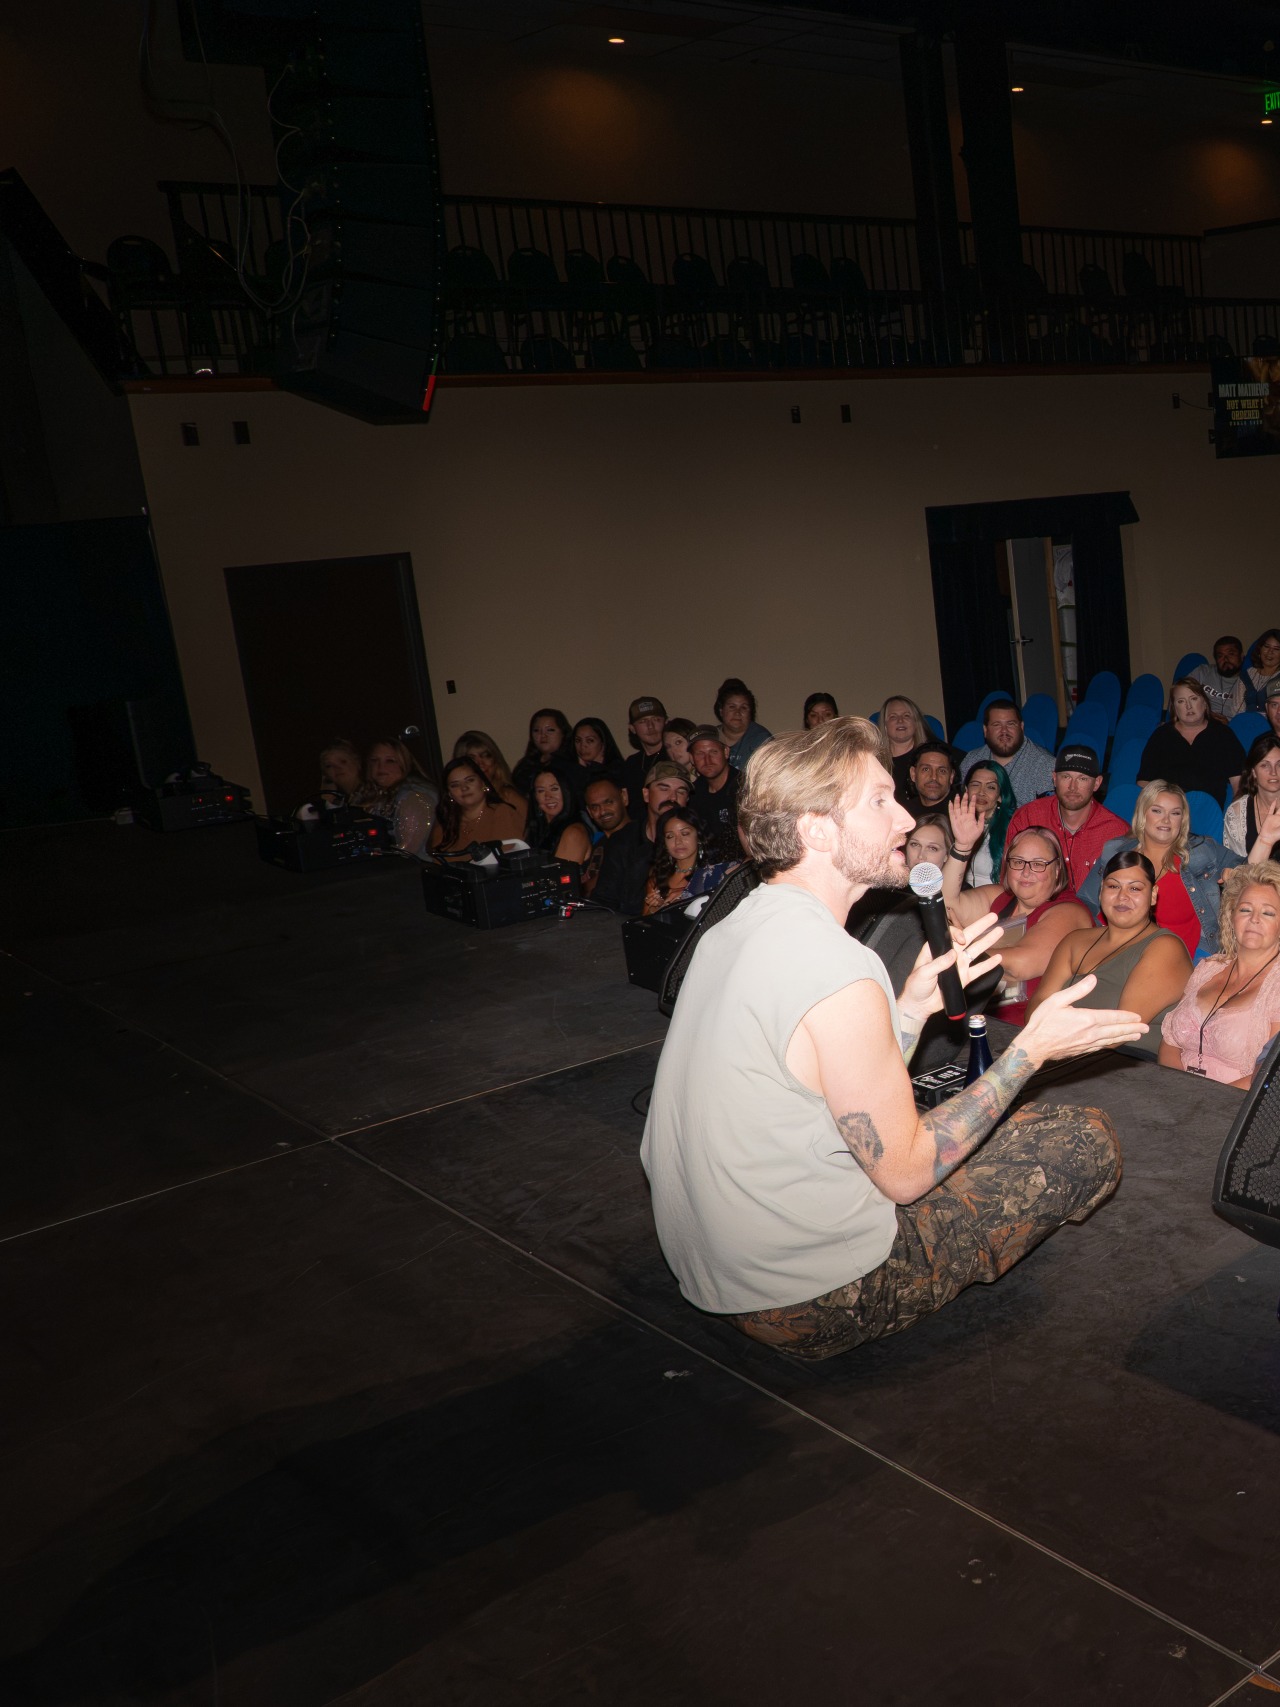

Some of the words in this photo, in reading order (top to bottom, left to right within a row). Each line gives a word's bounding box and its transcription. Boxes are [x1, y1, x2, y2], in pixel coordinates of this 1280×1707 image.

[1264, 91, 1280, 111] EXIT
[1218, 383, 1237, 398] MATT
[1237, 382, 1270, 397] MATHEWS
[1226, 399, 1240, 411] NOT
